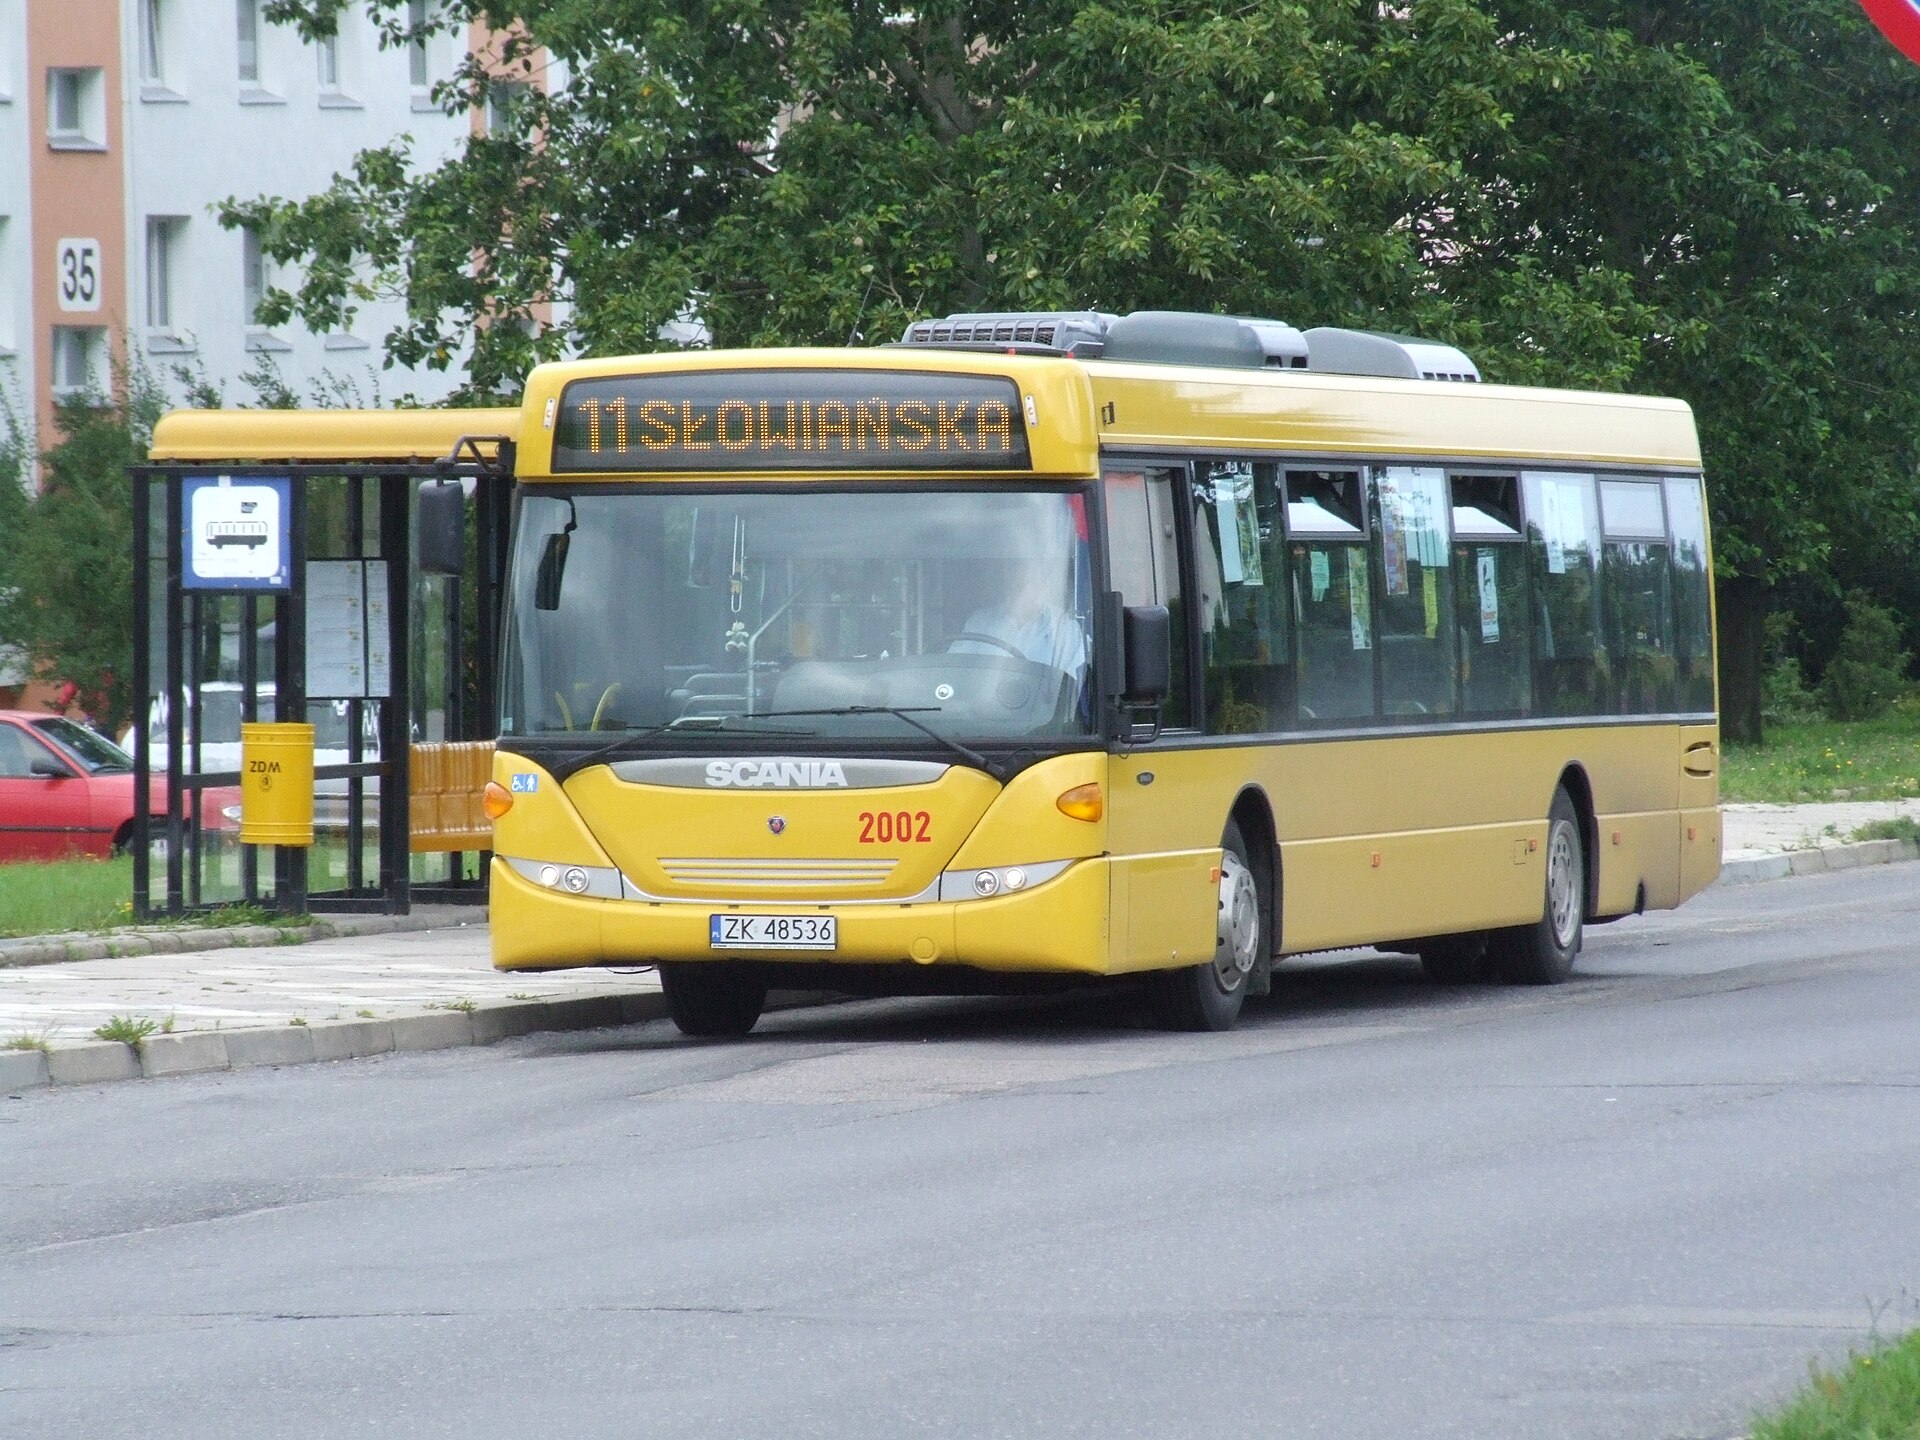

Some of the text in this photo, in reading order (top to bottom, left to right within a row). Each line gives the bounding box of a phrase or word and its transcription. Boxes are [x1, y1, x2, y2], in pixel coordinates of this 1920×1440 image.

[63, 247, 95, 301] 35
[579, 396, 1010, 453] 11 SŁOWIAŃSKA
[250, 760, 281, 773] ZDM
[705, 761, 848, 787] SCANIA
[858, 811, 931, 843] 2002
[725, 918, 831, 940] ZK 48536
